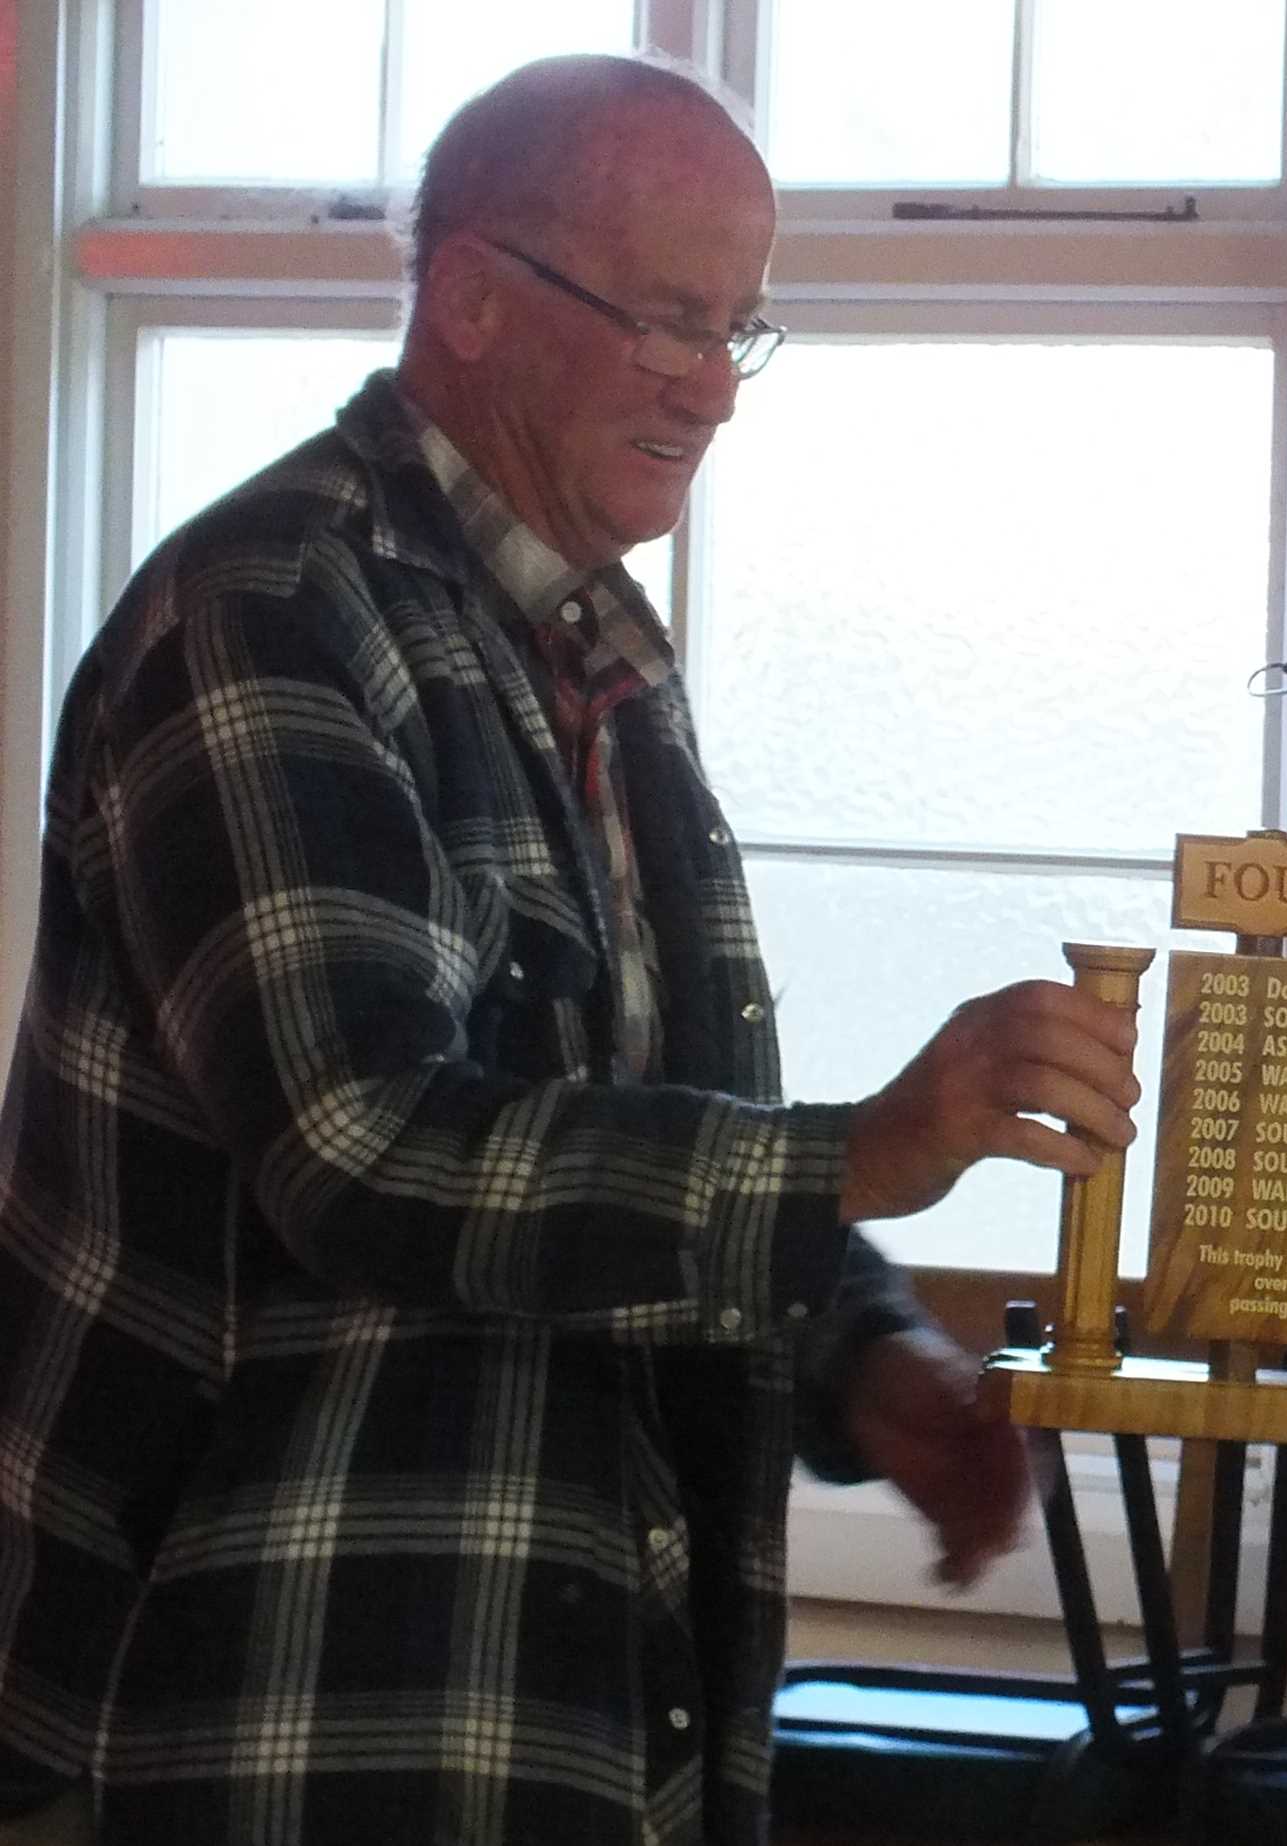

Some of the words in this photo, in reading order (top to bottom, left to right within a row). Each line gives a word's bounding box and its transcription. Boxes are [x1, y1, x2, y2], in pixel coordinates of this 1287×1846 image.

[1200, 972, 1249, 997] 2003
[1199, 1001, 1247, 1026] 2003
[1198, 1030, 1244, 1055] 2004
[1194, 1060, 1243, 1084] 2005
[1192, 1088, 1241, 1113] 2006
[1191, 1117, 1240, 1141] 2007
[1188, 1146, 1236, 1170] 2008
[1186, 1175, 1234, 1199] 2009
[1184, 1203, 1232, 1228] 2010
[1199, 1245, 1229, 1264] This
[1233, 1249, 1283, 1272] trophy
[1254, 1276, 1287, 1292] over
[1230, 1297, 1287, 1319] passing
